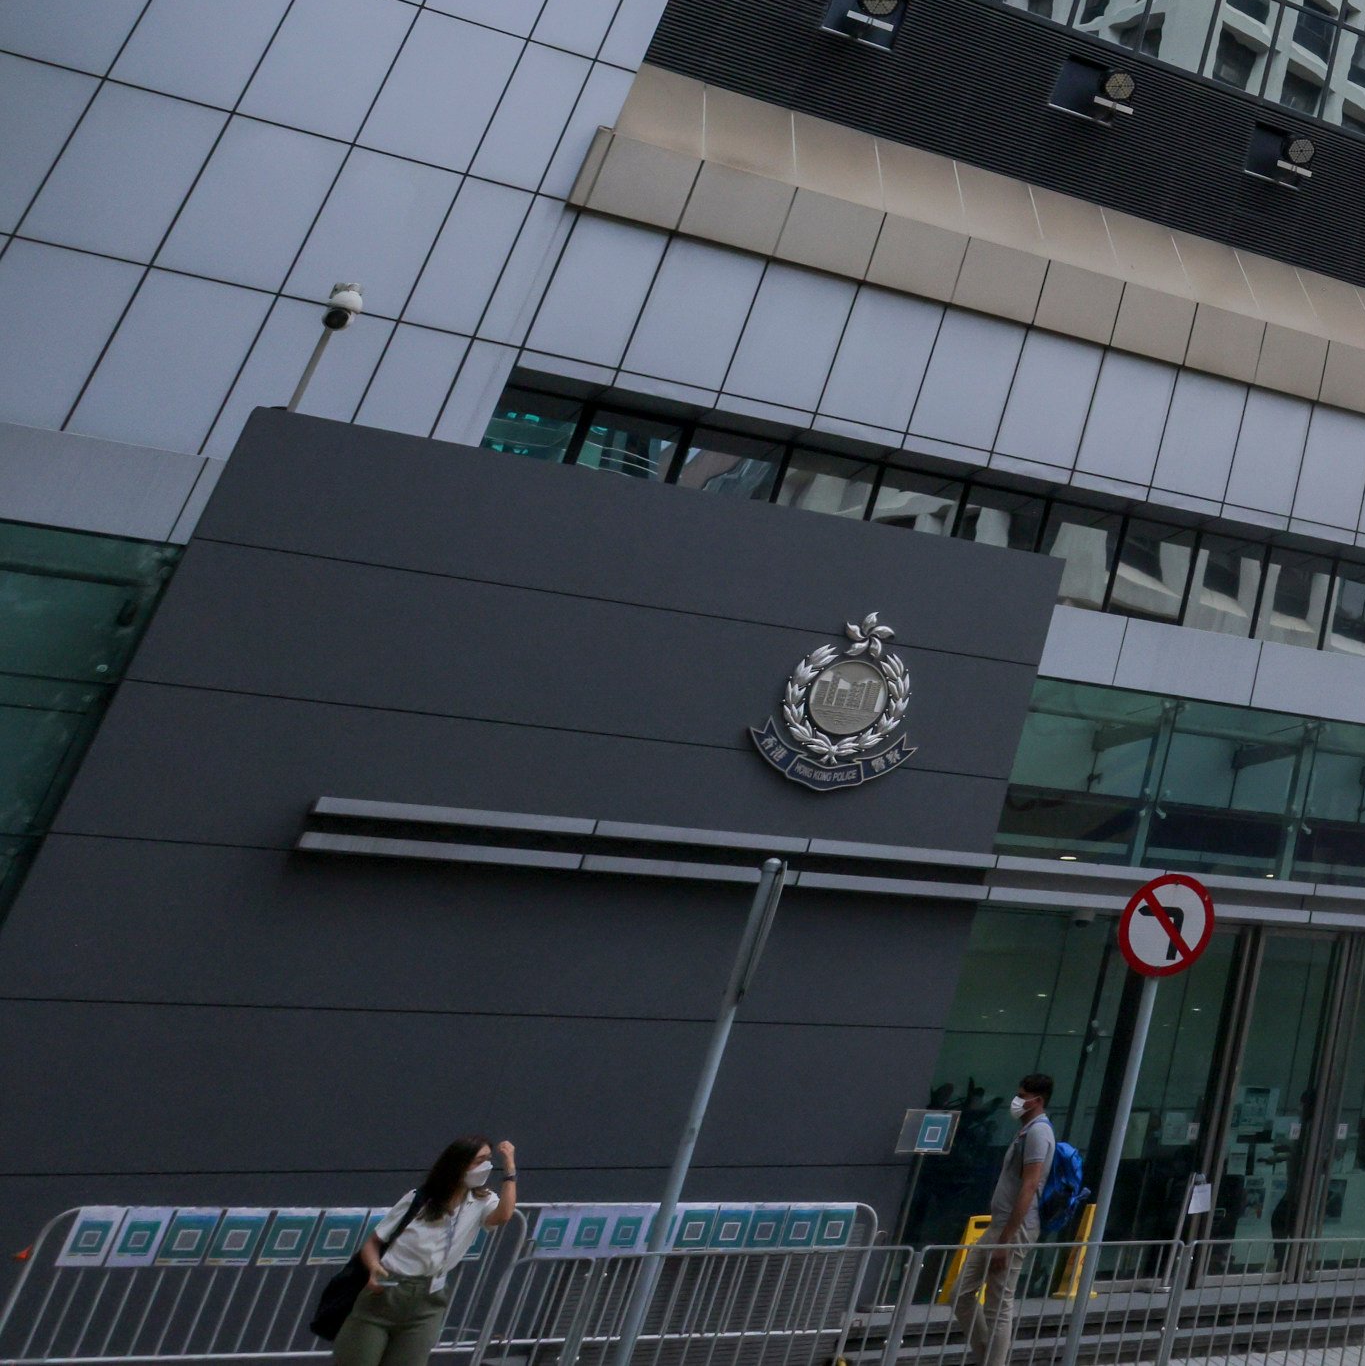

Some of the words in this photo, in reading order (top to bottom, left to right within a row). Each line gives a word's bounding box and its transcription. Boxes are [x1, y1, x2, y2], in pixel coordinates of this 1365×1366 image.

[760, 735, 789, 763] 香港
[794, 762, 814, 779] HONG
[813, 771, 832, 782] KONG
[832, 769, 857, 782] POLICE
